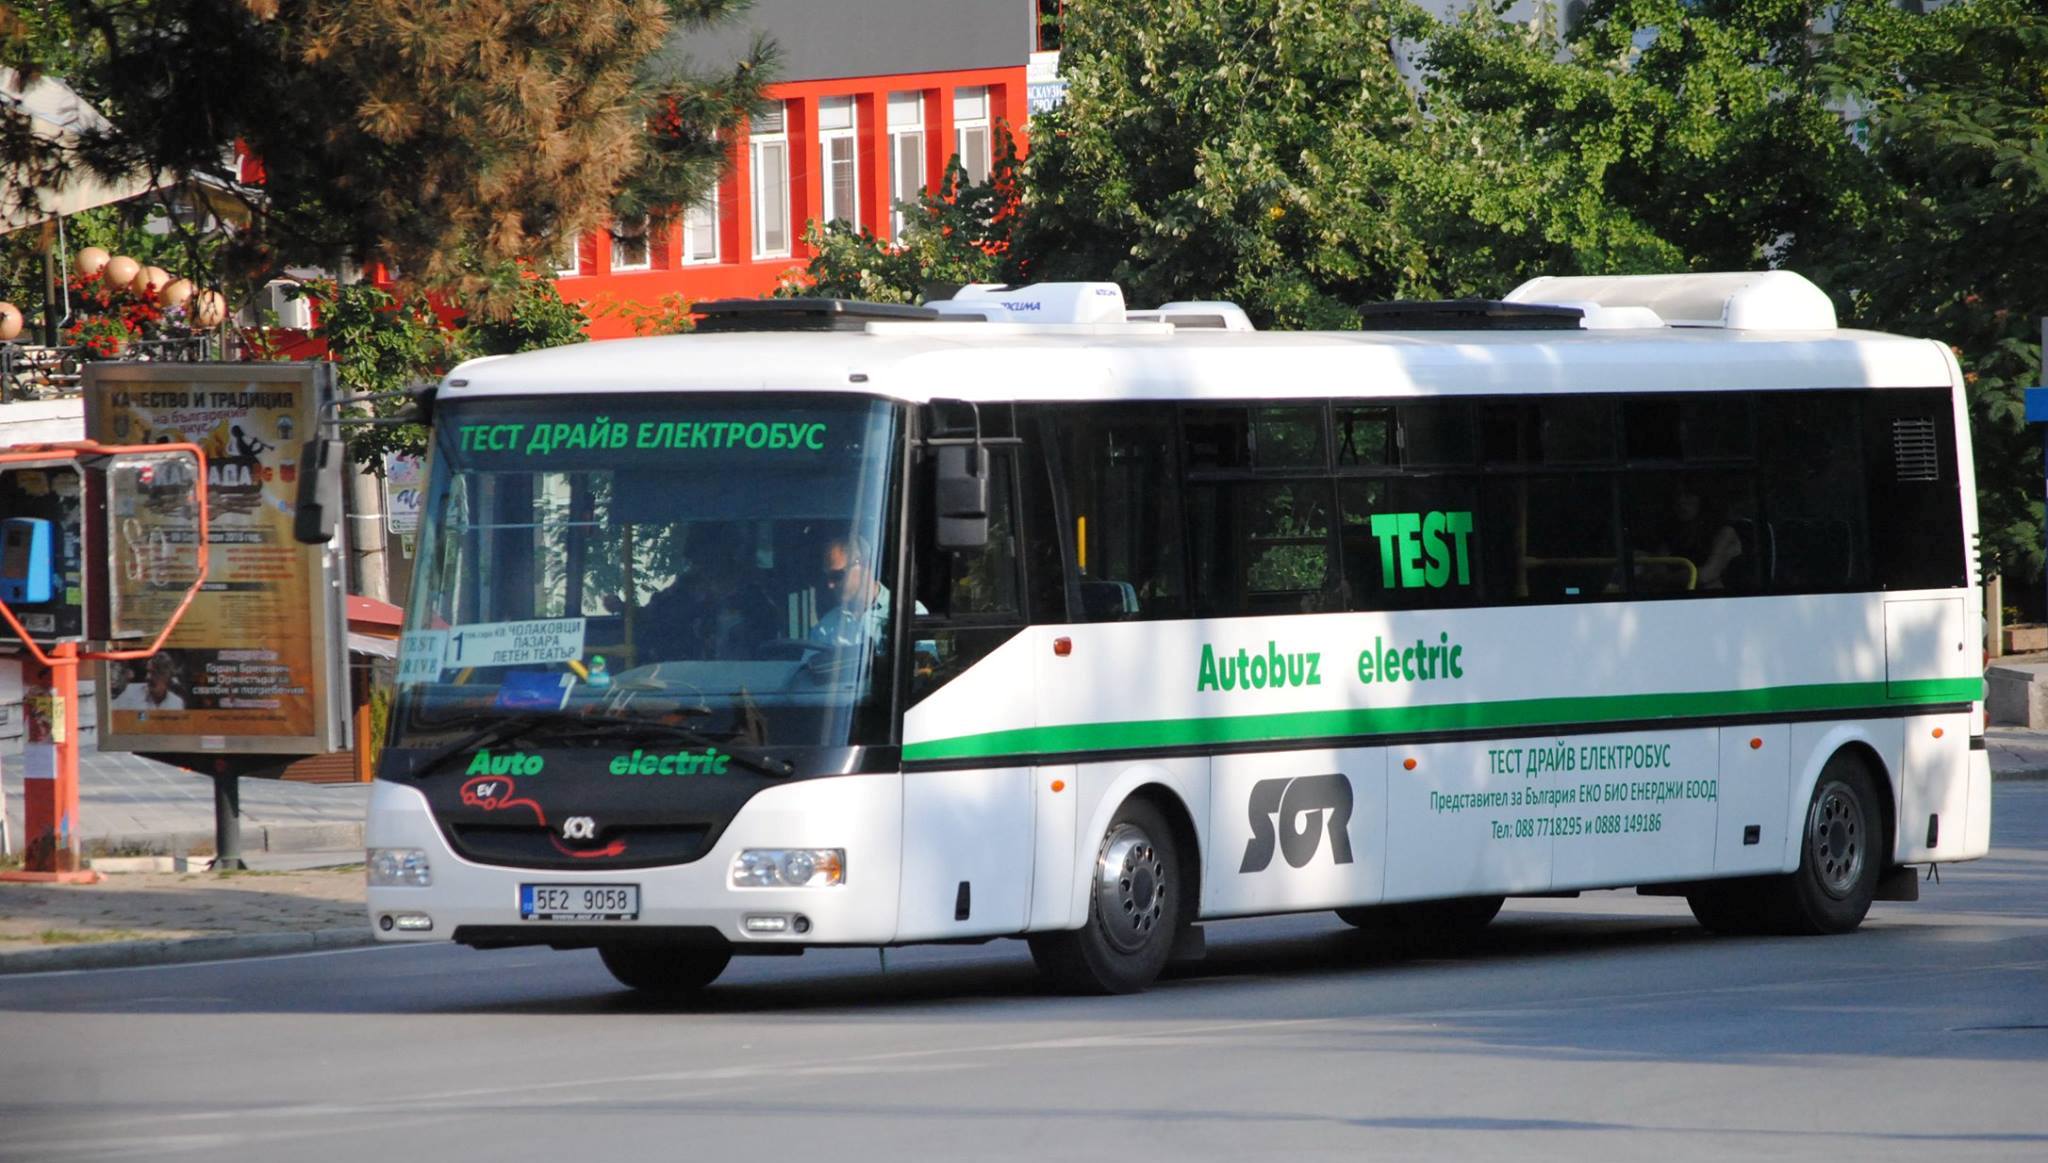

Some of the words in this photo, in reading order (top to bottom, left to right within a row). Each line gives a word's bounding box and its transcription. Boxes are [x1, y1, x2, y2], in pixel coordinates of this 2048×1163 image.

[112, 392, 188, 408] КАЧЕСТВО
[193, 392, 205, 408] И
[210, 392, 293, 409] ТРАДИЦИЯ
[153, 414, 169, 424] на
[460, 425, 525, 451] ТЕСТ
[526, 417, 628, 454] ДРАЙВ
[636, 422, 827, 450] ЕЛЕКТРОБУС
[1370, 510, 1473, 589] TEST
[508, 621, 581, 637] ЧОЛАКОВЦИ
[452, 632, 464, 661] 1
[514, 635, 559, 649] ПАЗАРА
[399, 658, 438, 673] RIVE
[493, 650, 529, 663] ЛЕТЕН
[533, 647, 576, 660] ТЕАТЪР
[1197, 640, 1321, 692] Autobuz
[1358, 631, 1463, 684] electric
[206, 663, 237, 673] Горан
[193, 685, 229, 695] сватби
[241, 685, 305, 696] погребения
[465, 749, 545, 776] Auto
[609, 747, 732, 776] electric
[1489, 749, 1523, 774] ТЕСТ
[1526, 742, 1576, 778] ДРАЙВ
[1580, 744, 1671, 772] ЕЛЕКТРОБУС
[477, 782, 497, 797] EV
[1430, 790, 1508, 814] Представител
[1510, 793, 1522, 807] за
[1525, 786, 1576, 808] България
[1579, 784, 1601, 803] ЕКО
[1604, 782, 1628, 802] БИО
[1631, 780, 1683, 803] ЕНЕРДЖИ
[1686, 779, 1717, 802] ЕООД
[562, 815, 596, 839] SOR
[1238, 773, 1354, 874] SOR
[1491, 820, 1513, 839] Тел:
[1515, 818, 1534, 838] 088
[1537, 815, 1582, 837] 7718295
[1585, 820, 1592, 834] и
[1595, 815, 1620, 835] 0888
[1623, 813, 1661, 833] 149186
[537, 890, 569, 910] 5E2
[584, 890, 627, 910] 9058
